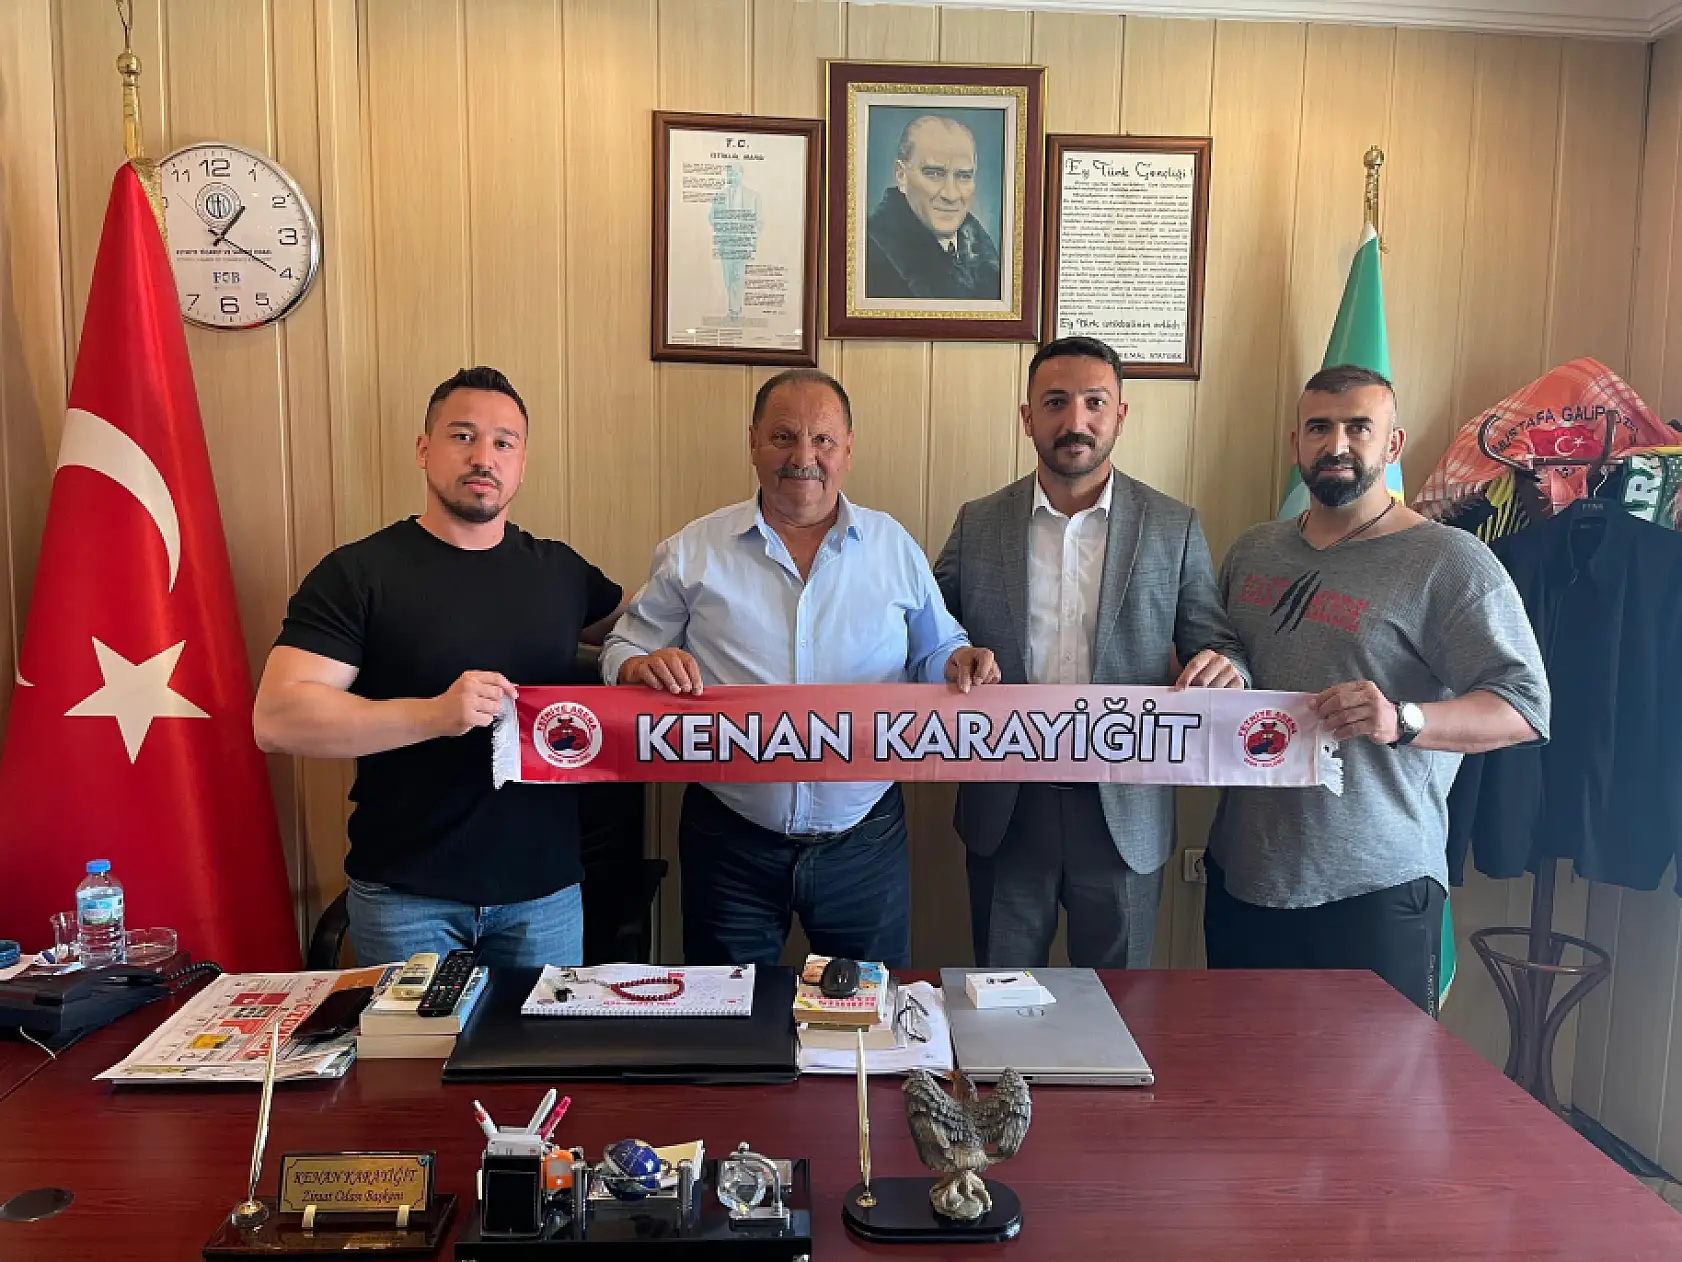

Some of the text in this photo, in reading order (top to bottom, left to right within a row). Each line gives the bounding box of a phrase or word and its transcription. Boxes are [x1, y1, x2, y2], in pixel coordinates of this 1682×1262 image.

[171, 168, 191, 183] 11
[199, 158, 231, 178] 12
[248, 168, 257, 183] 1
[1065, 158, 1090, 180] Ey
[1093, 159, 1129, 177] Türk
[272, 196, 287, 209] 2
[278, 227, 298, 245] 3
[279, 267, 293, 279] 4
[186, 293, 201, 311] 7
[220, 297, 240, 314] 6
[256, 292, 270, 306] 5
[1060, 317, 1074, 330] Ey
[1076, 317, 1100, 329] Türk
[1561, 404, 1606, 422] GALİP
[636, 698, 1201, 763] KENAN KARAYİĞİT
[293, 1167, 418, 1187] KENAN KARAYİĞİT
[302, 1187, 404, 1204] Ziraat Odası Başkanı
